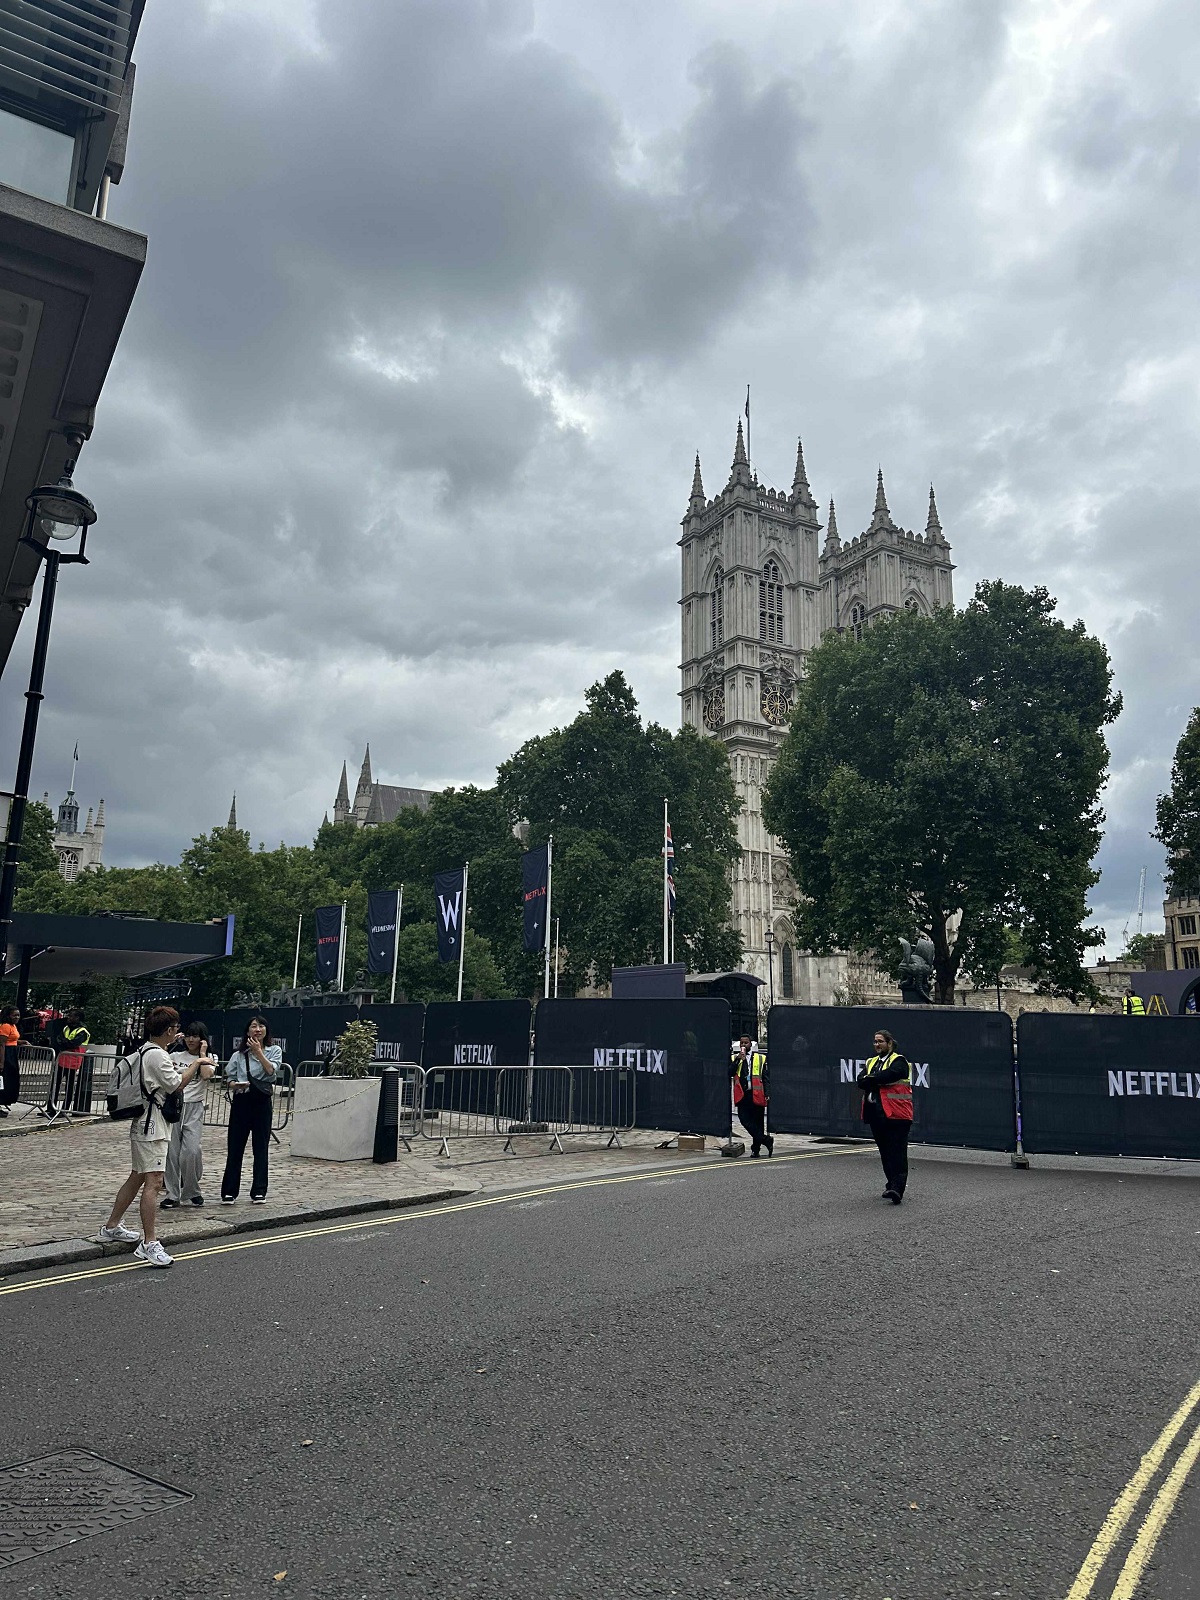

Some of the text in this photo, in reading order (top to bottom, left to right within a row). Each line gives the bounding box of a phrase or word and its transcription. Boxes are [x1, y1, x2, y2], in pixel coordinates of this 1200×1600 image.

[437, 890, 462, 932] W
[375, 1042, 401, 1061] NETFLIX
[453, 1044, 494, 1066] NETFLIX
[593, 1048, 665, 1075] NETFLIX
[840, 1058, 930, 1089] NEIX
